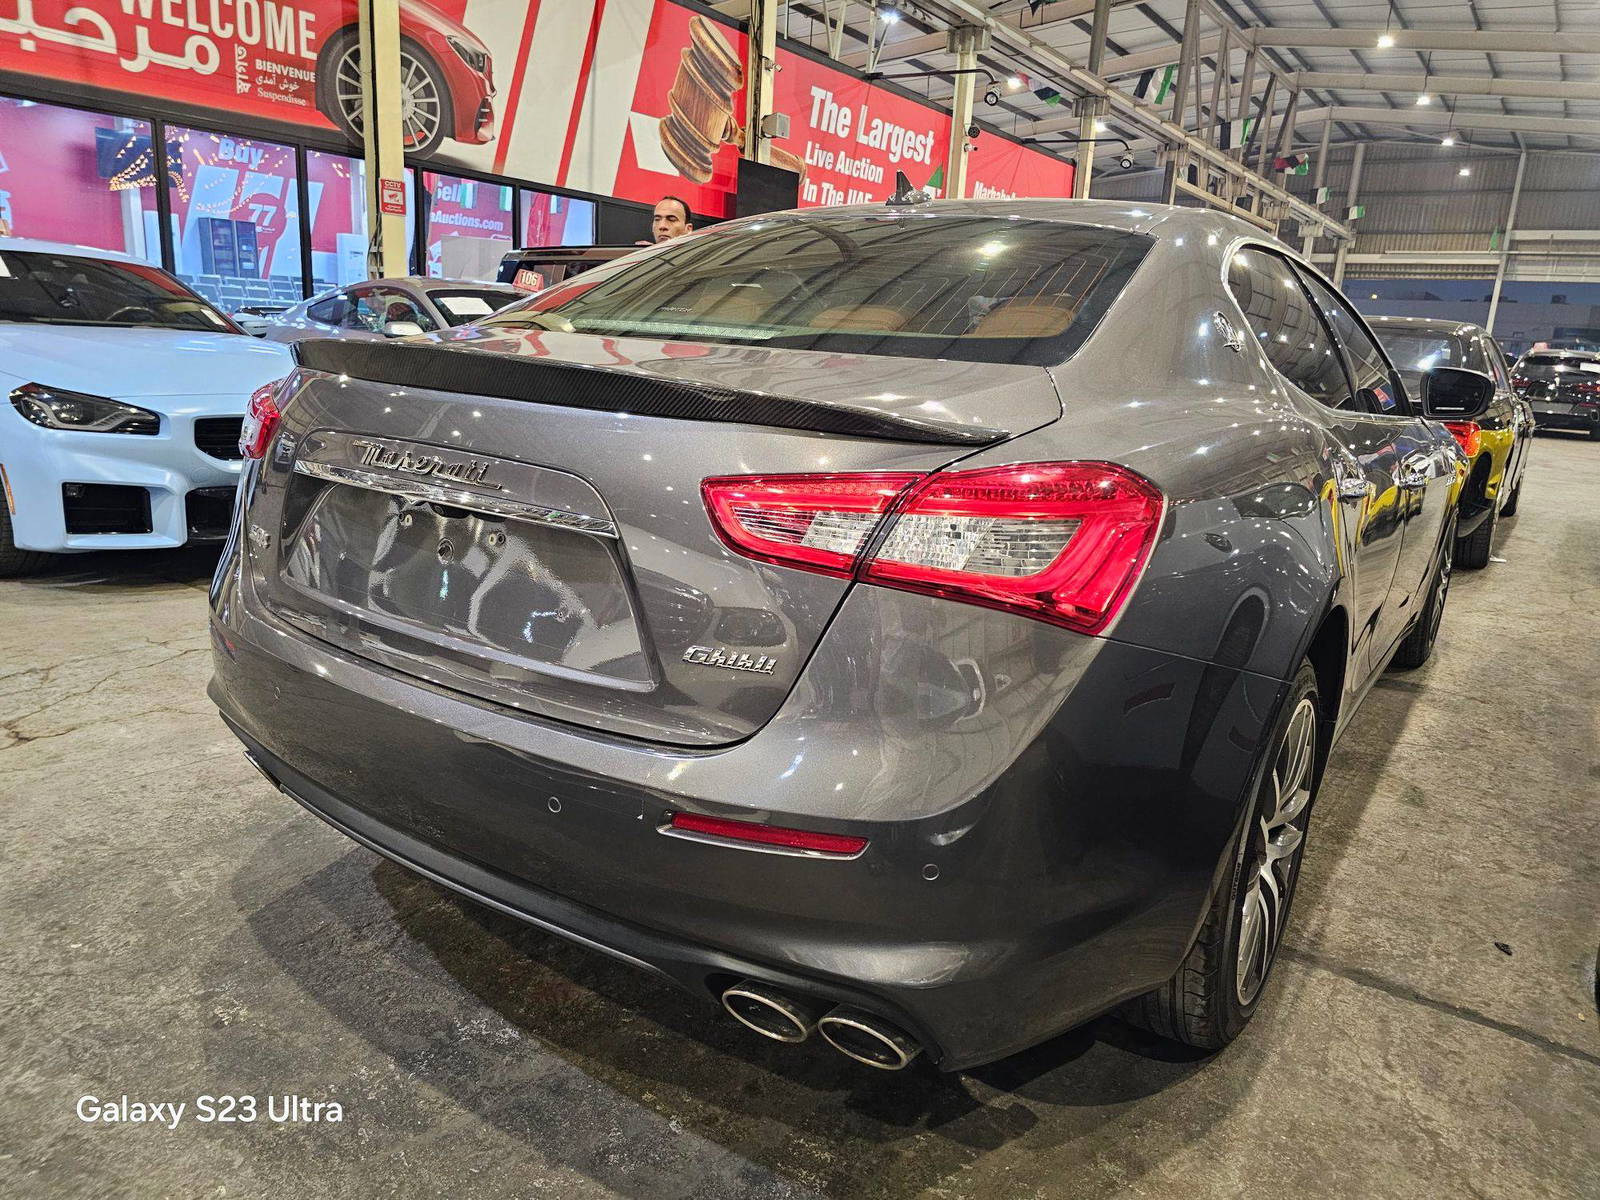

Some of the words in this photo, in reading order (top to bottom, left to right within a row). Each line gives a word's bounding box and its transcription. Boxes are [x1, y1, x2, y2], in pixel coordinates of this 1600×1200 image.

[0, 0, 220, 75] مرحب
[255, 58, 316, 83] BIENVENUE
[809, 85, 851, 138] The
[856, 104, 935, 165] Largest
[218, 137, 264, 170] Buy
[805, 140, 834, 170] Live
[835, 150, 884, 184] Auction
[384, 181, 401, 189] CCTV
[803, 178, 818, 202] In
[821, 182, 845, 206] The
[248, 202, 278, 227] 77
[521, 271, 537, 286] 106
[352, 439, 503, 490] Maserati
[682, 645, 777, 675] Ghibli
